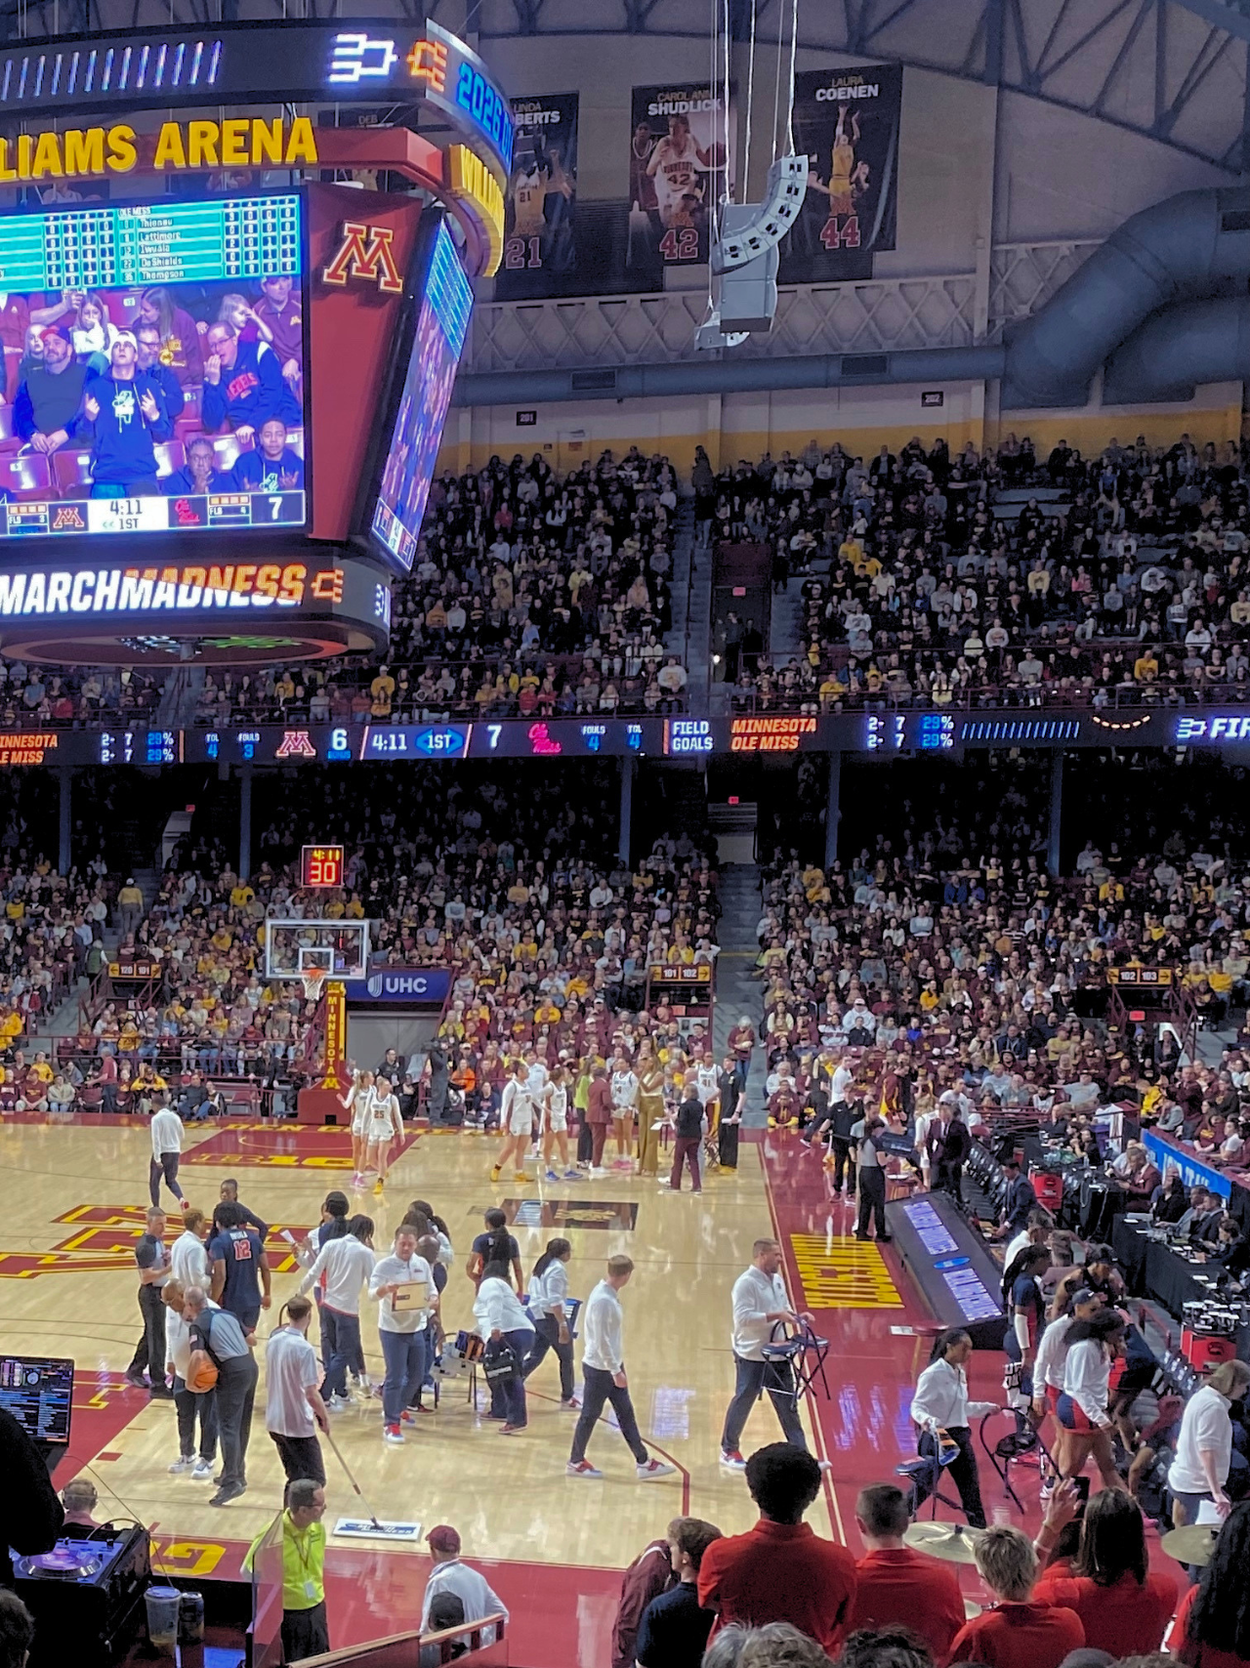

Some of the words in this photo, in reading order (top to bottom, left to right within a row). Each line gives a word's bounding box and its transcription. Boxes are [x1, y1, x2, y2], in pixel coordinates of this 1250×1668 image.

[831, 75, 864, 87] LAURA
[657, 92, 688, 103] CAROL
[815, 83, 879, 102] COENEN
[458, 62, 501, 142] 2026
[514, 101, 542, 113] LINDA
[648, 98, 722, 116] SHUDLICK
[514, 110, 561, 126] BERTS
[154, 117, 319, 170] ARENA
[667, 173, 691, 185] 42
[819, 216, 861, 249] 44
[659, 228, 699, 260] 42
[505, 237, 542, 270] 21
[109, 500, 143, 515] 4:11
[269, 496, 283, 520] 7
[119, 517, 139, 530] 1ST
[582, 725, 605, 735] FOULS
[673, 721, 709, 735] FIELD
[731, 718, 817, 733] MINNESOTA
[895, 716, 905, 730] 7
[125, 733, 133, 745] 7
[332, 728, 348, 750] 6
[372, 734, 407, 750] 4:11
[428, 735, 451, 749] 1ST
[487, 725, 502, 748] 7
[588, 736, 600, 751] 4
[629, 735, 640, 750] 4
[673, 736, 713, 751] GOALS
[731, 736, 758, 751] OLE
[760, 735, 799, 750] MISS
[895, 734, 905, 748] 7
[10, 750, 44, 763] MISS
[125, 749, 133, 762] 7
[208, 744, 218, 758] 4
[244, 744, 253, 758] 3
[314, 850, 340, 860] 4:11
[311, 863, 336, 883] 30
[120, 966, 133, 975] 120
[663, 969, 677, 977] 101
[683, 969, 697, 977] 102
[1120, 972, 1136, 980] 102
[1142, 972, 1157, 980] 103
[385, 977, 428, 994] UHC
[327, 996, 337, 1074] MINNESOTA
[374, 1110, 384, 1119] 25
[233, 1239, 251, 1260] 12
